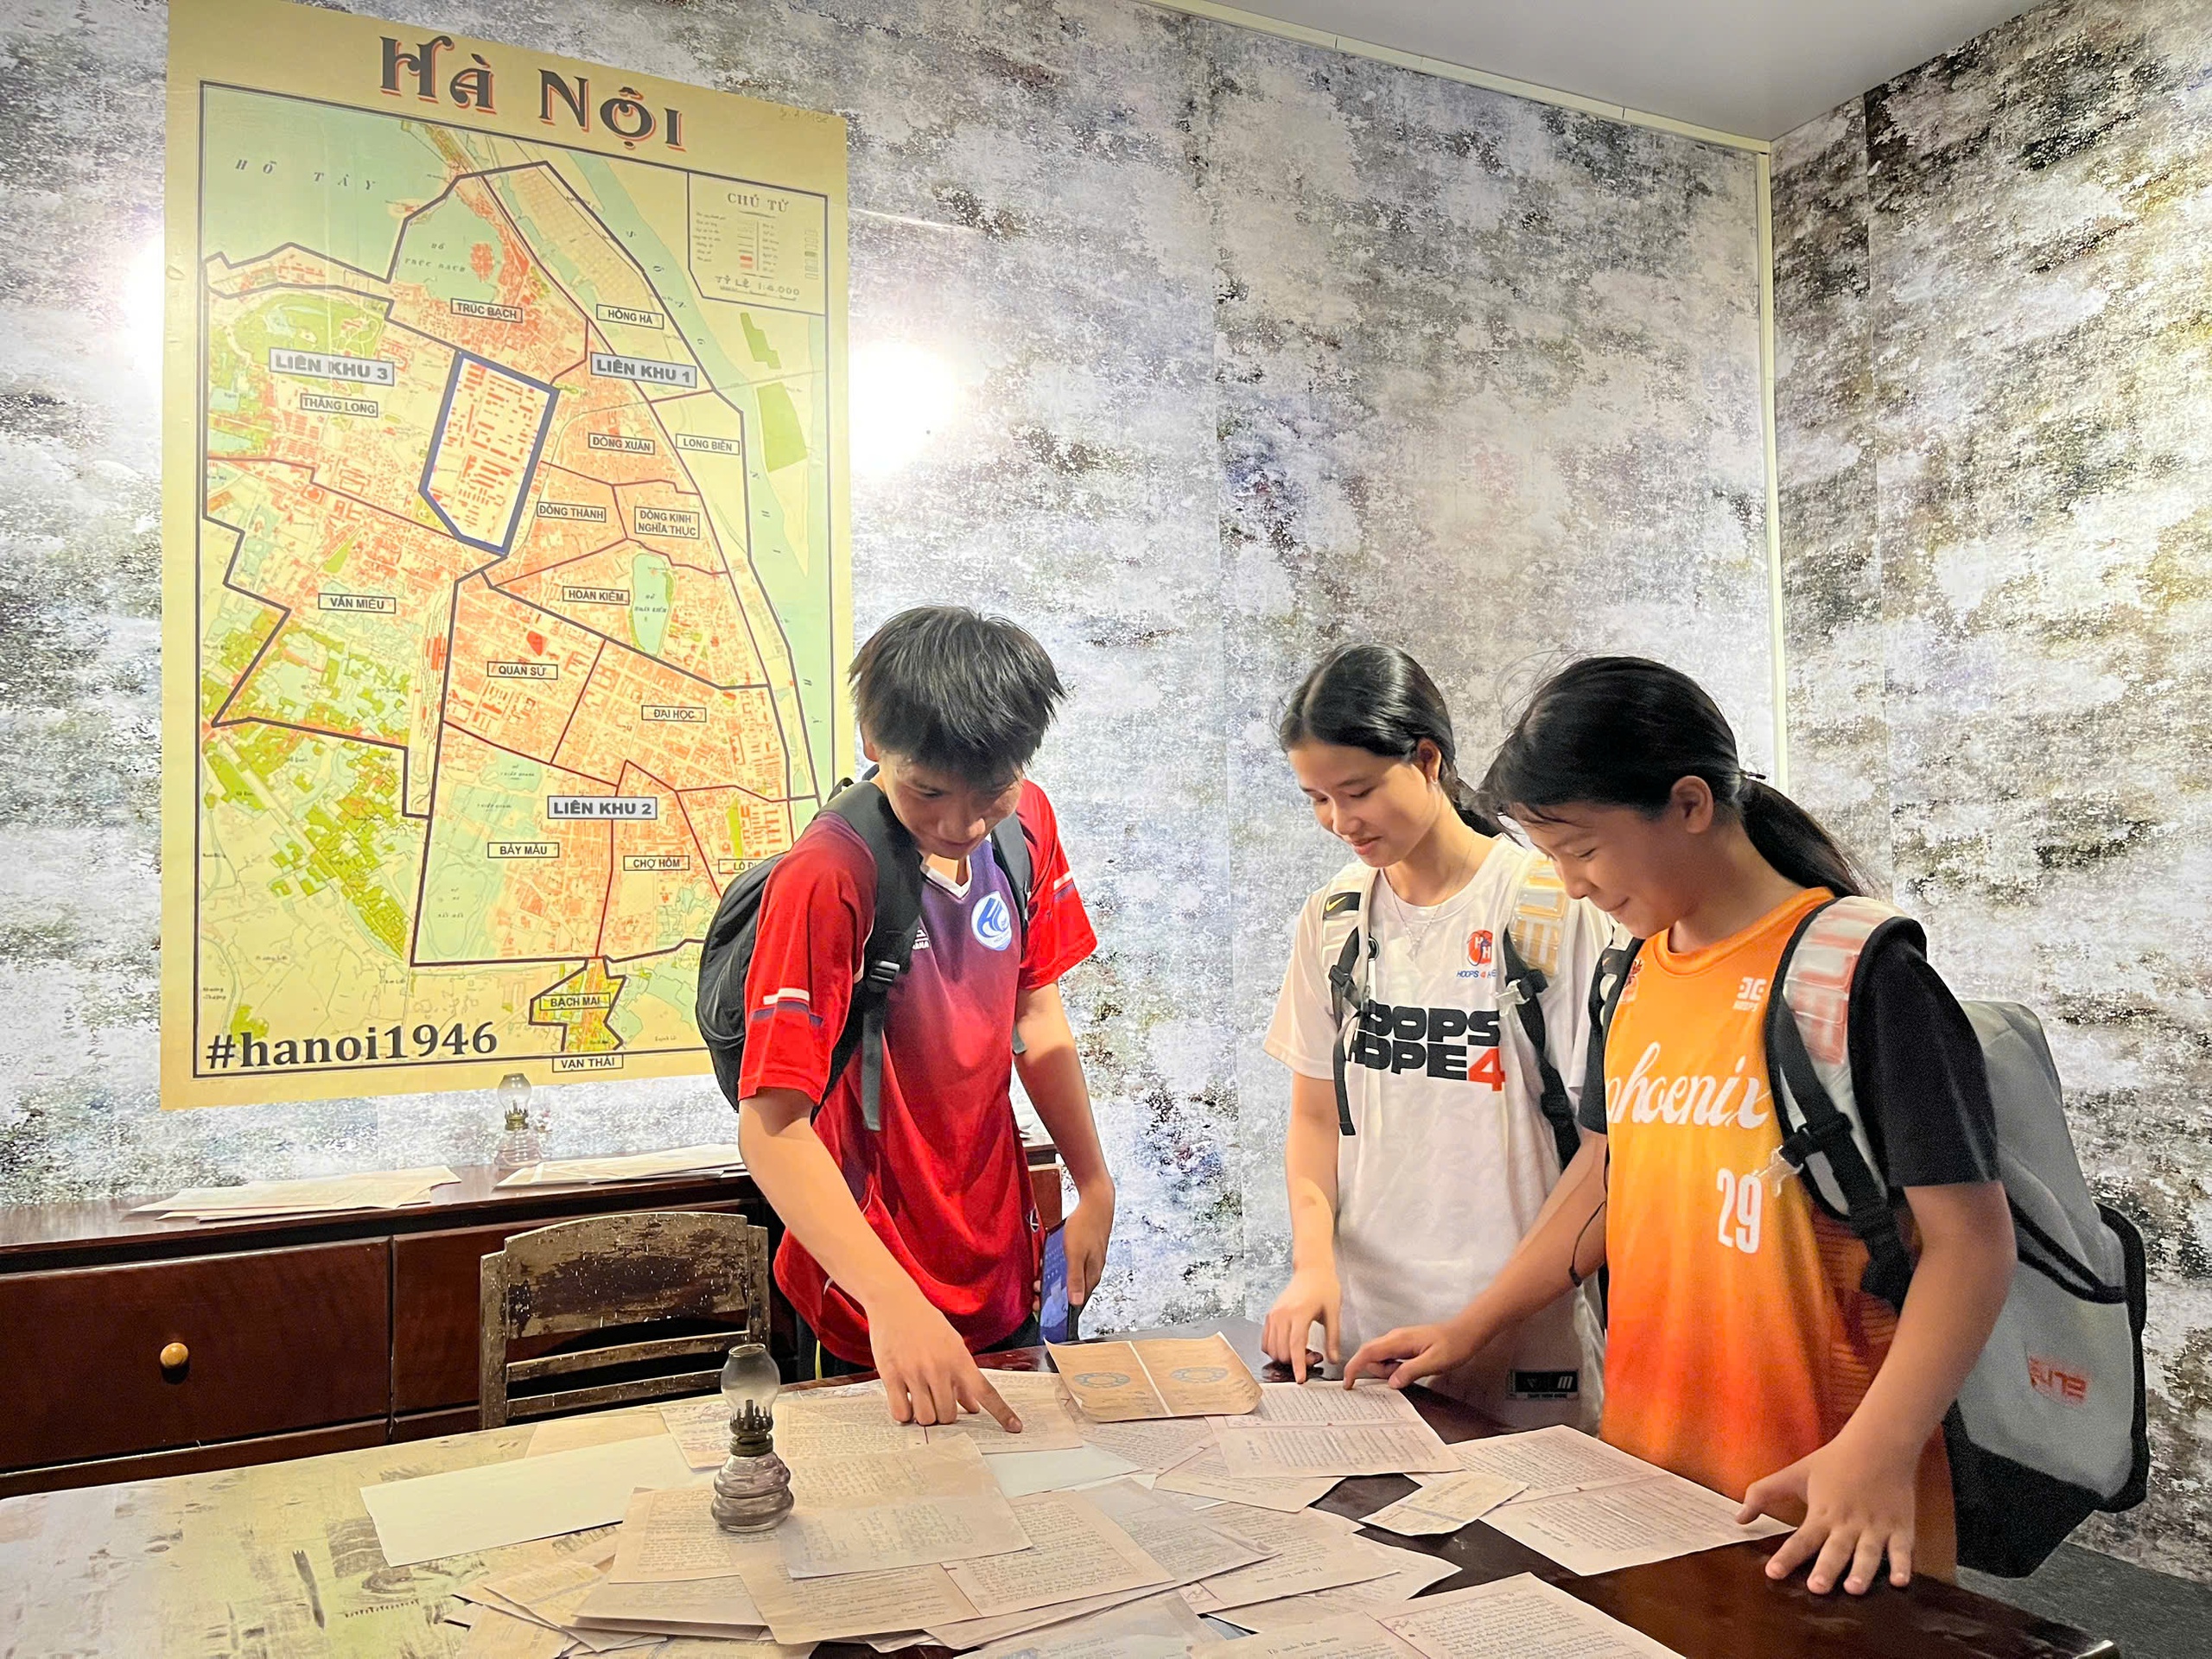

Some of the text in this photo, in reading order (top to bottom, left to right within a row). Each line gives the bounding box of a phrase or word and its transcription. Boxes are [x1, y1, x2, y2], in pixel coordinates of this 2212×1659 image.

[487, 307, 517, 320] BẠCH
[276, 354, 388, 379] LIÊN KHU 3
[597, 359, 690, 383] LIÊN KHU 1
[346, 402, 375, 414] LONG
[683, 438, 709, 449] LONG
[670, 513, 691, 523] KINH
[653, 709, 695, 721] ĐẠI HỌC
[554, 799, 652, 815] LIÊN KHU 2
[633, 857, 680, 868] CHỢ HÔM
[551, 996, 601, 1009] BẠCH MAI
[206, 1021, 498, 1069] #hanoi1946
[561, 1059, 584, 1071] VẠN
[1717, 1167, 1763, 1254] 29
